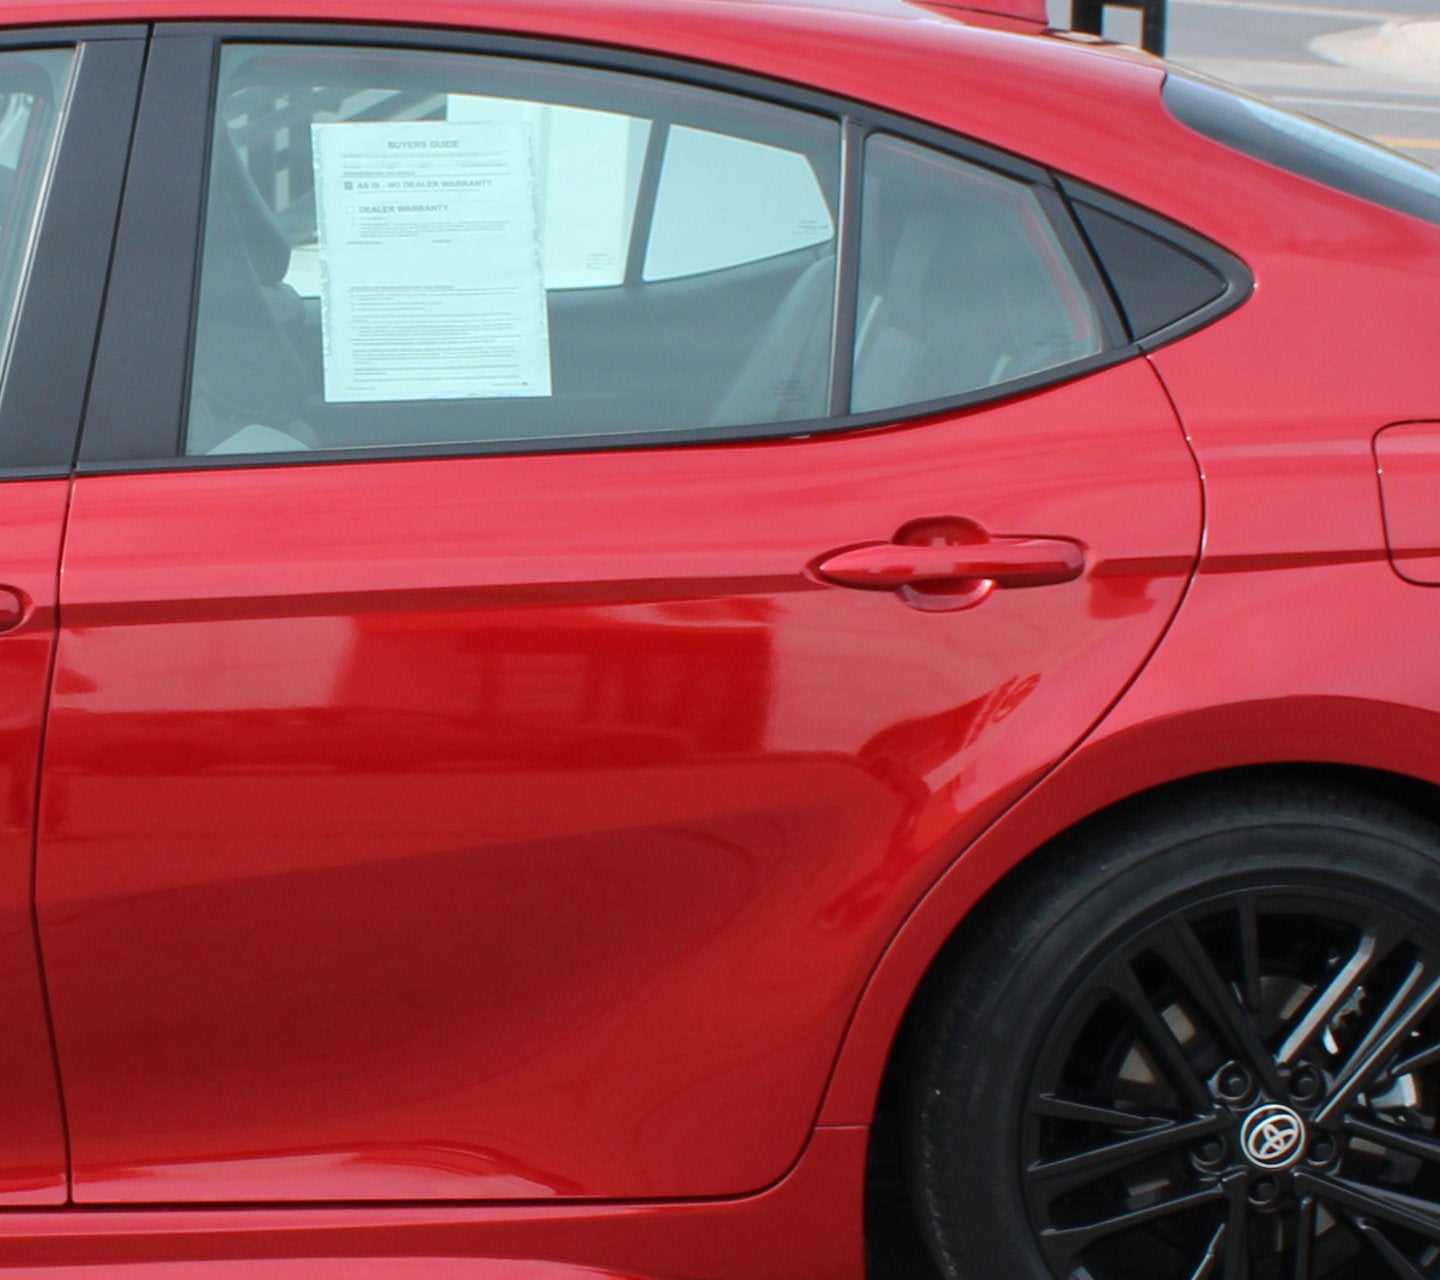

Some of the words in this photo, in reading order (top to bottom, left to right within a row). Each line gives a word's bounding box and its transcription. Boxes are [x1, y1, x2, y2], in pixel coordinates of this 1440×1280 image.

[387, 140, 428, 150] BUYERS
[429, 140, 460, 149] GUIDE
[357, 181, 370, 189] AS
[403, 180, 440, 189] DEALER
[441, 179, 493, 188] WARRANTY
[359, 205, 396, 214] DEALER
[397, 203, 449, 213] WARRANTY
